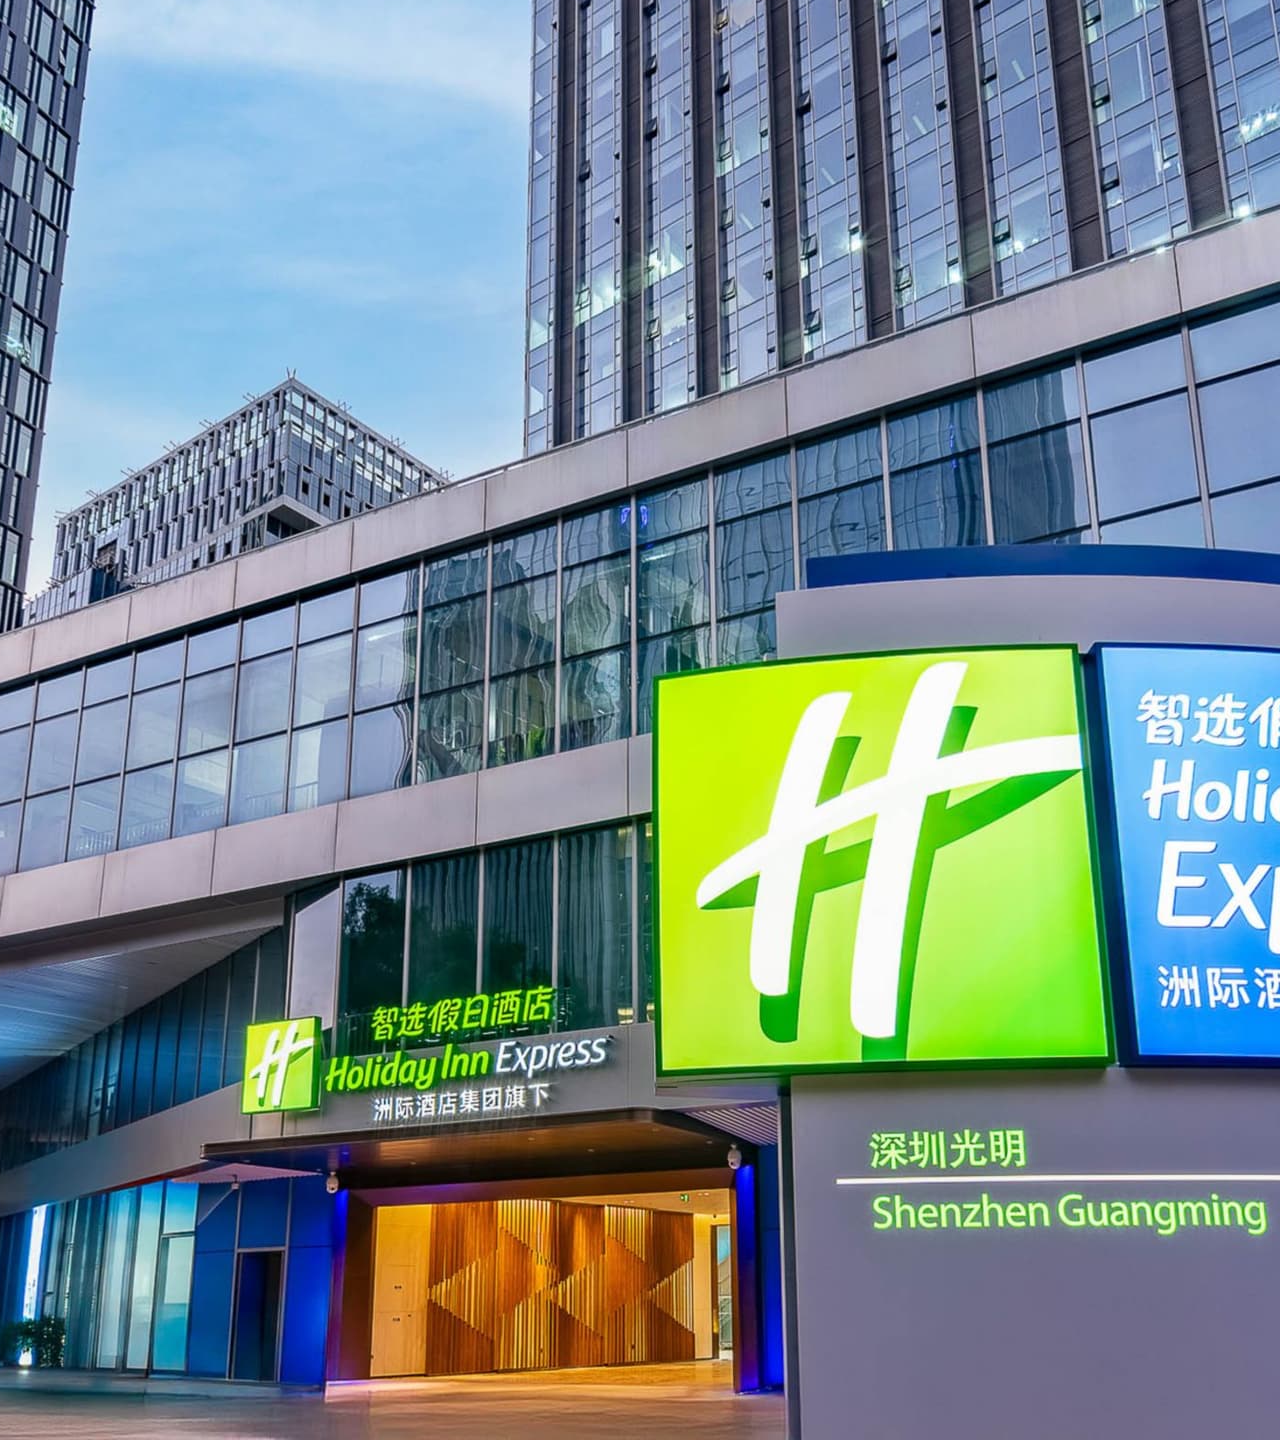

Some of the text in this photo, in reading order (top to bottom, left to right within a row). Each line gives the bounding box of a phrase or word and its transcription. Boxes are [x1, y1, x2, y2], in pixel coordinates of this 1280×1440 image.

[372, 986, 554, 1041] 智选假日酒店
[326, 1036, 610, 1093] Holiday Inn Express
[374, 1083, 551, 1122] 洲际酒店集团旗下
[869, 1131, 1028, 1169] 深圳光明
[873, 1194, 1268, 1235] Shenzhen Guangming
